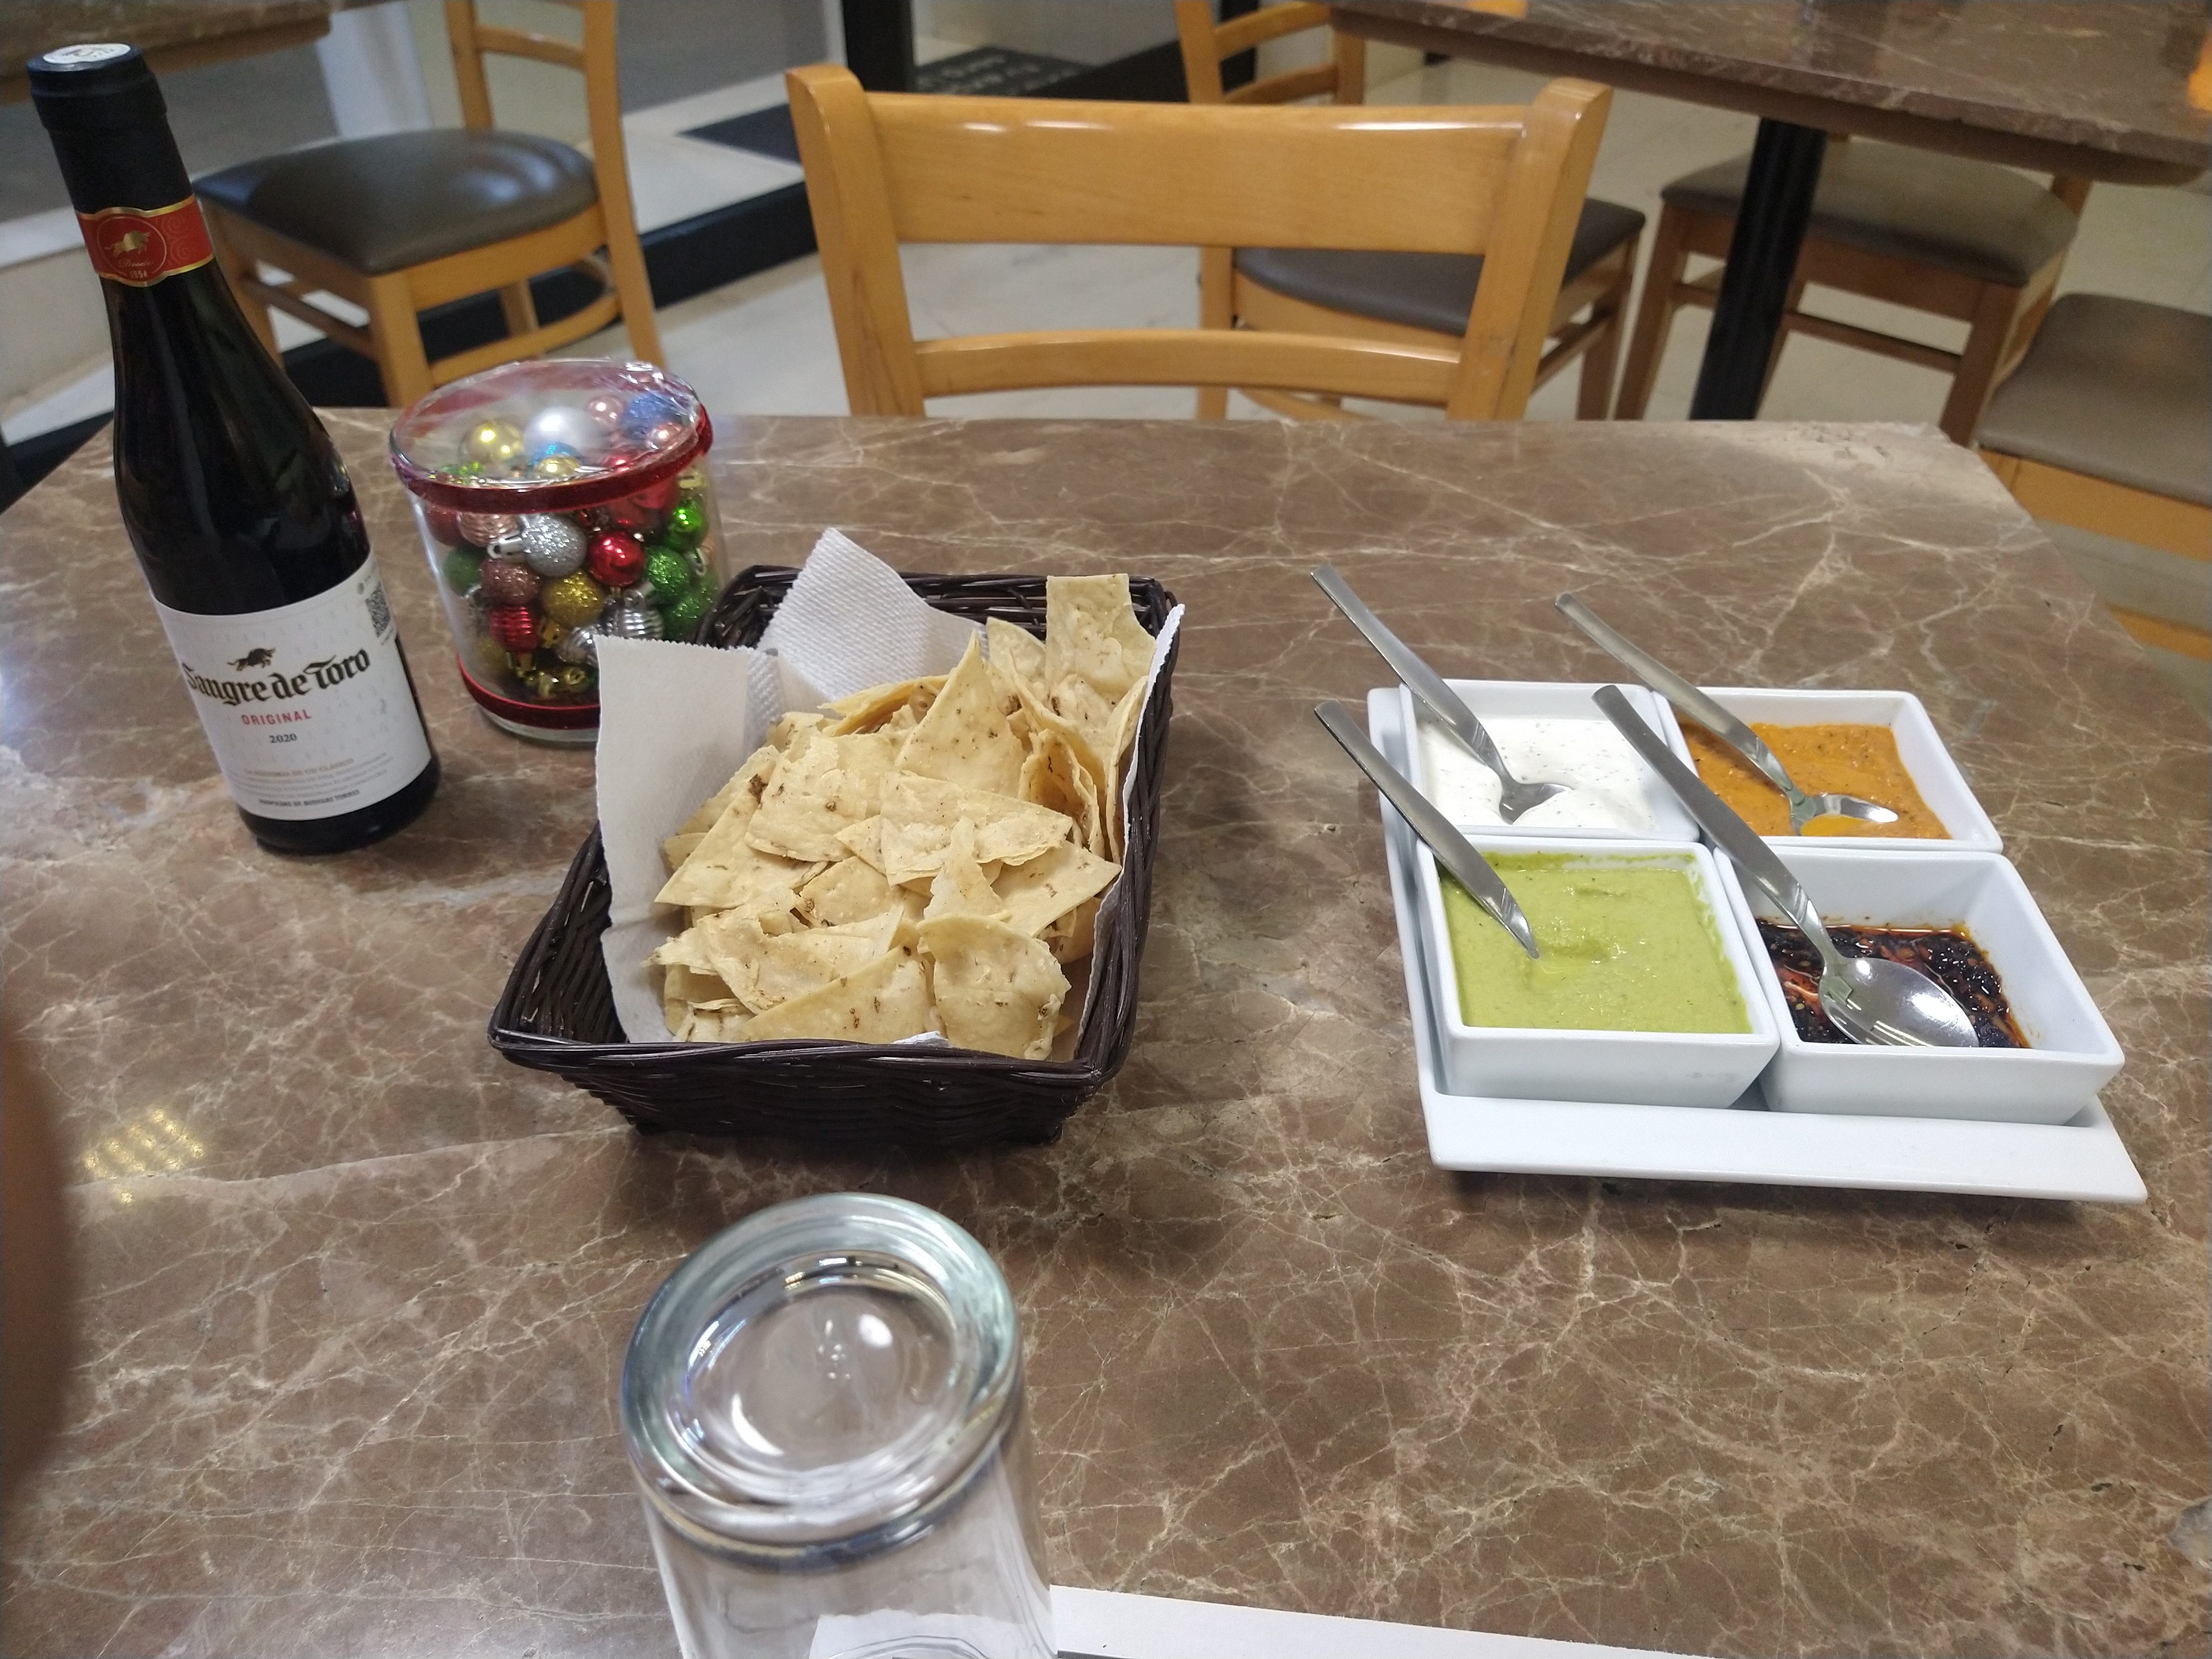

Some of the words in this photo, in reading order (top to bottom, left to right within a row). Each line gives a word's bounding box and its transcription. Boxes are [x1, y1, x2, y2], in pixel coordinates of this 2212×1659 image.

[181, 662, 272, 706] Sangre
[268, 672, 312, 700] de
[302, 648, 371, 690] Toro
[241, 709, 312, 725] ORIGINAL
[269, 733, 298, 744] 2020
